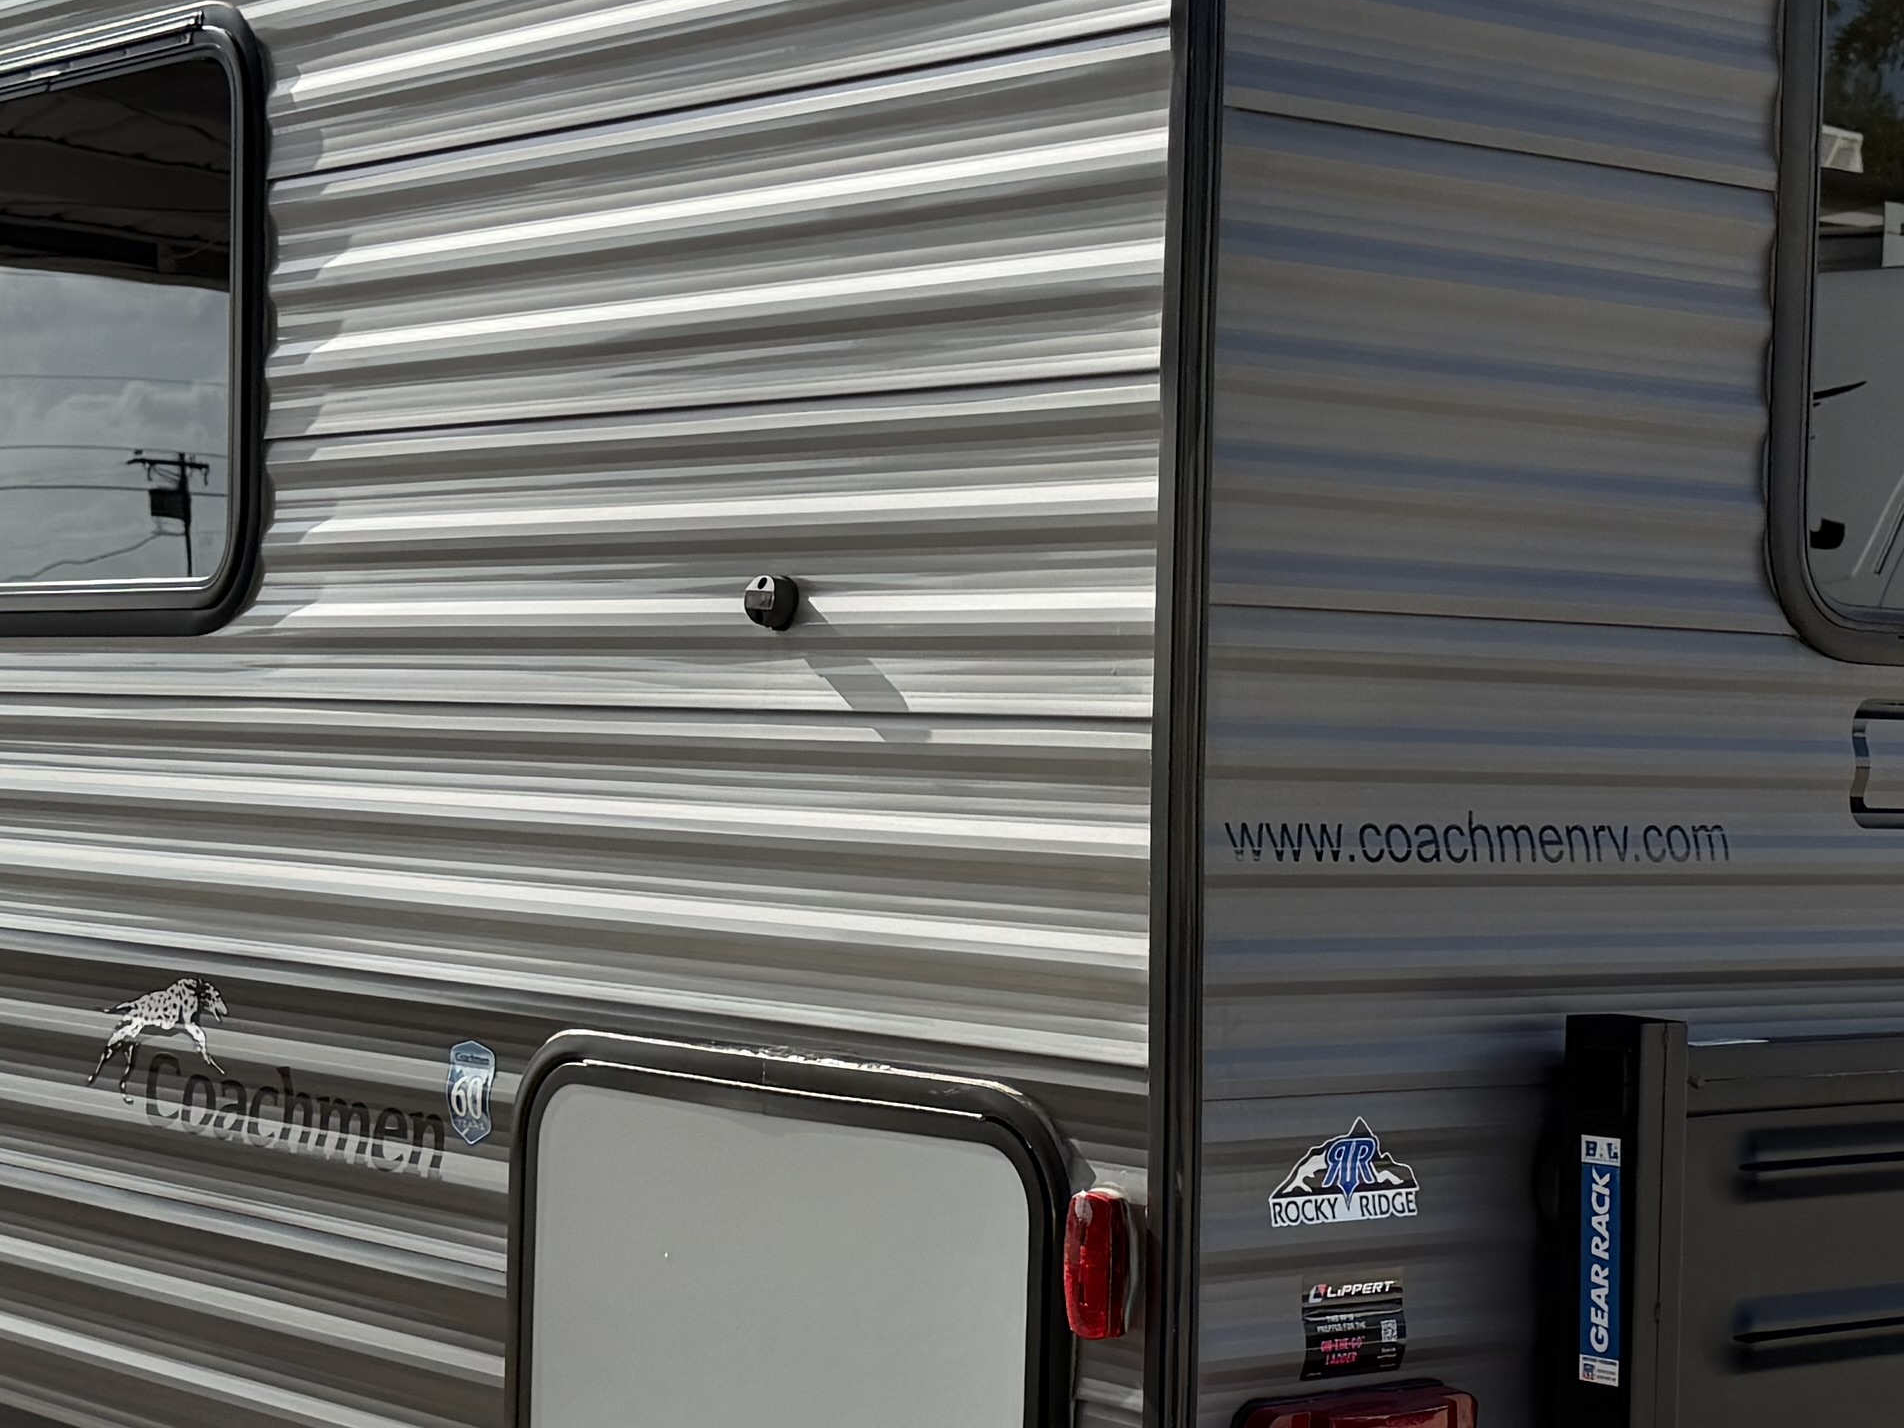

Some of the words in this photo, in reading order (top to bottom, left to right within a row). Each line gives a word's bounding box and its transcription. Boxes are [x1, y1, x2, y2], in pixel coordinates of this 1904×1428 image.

[1224, 810, 1730, 864] www.coachmenrv.com
[146, 1053, 446, 1174] Coachmen
[450, 1076, 483, 1120] 60
[1272, 1197, 1338, 1225] ROCKY
[1359, 1192, 1417, 1218] RIDGE
[1591, 1165, 1611, 1260] RACK
[1326, 1280, 1395, 1298] LIPPERT
[1590, 1263, 1610, 1353] GEAR
